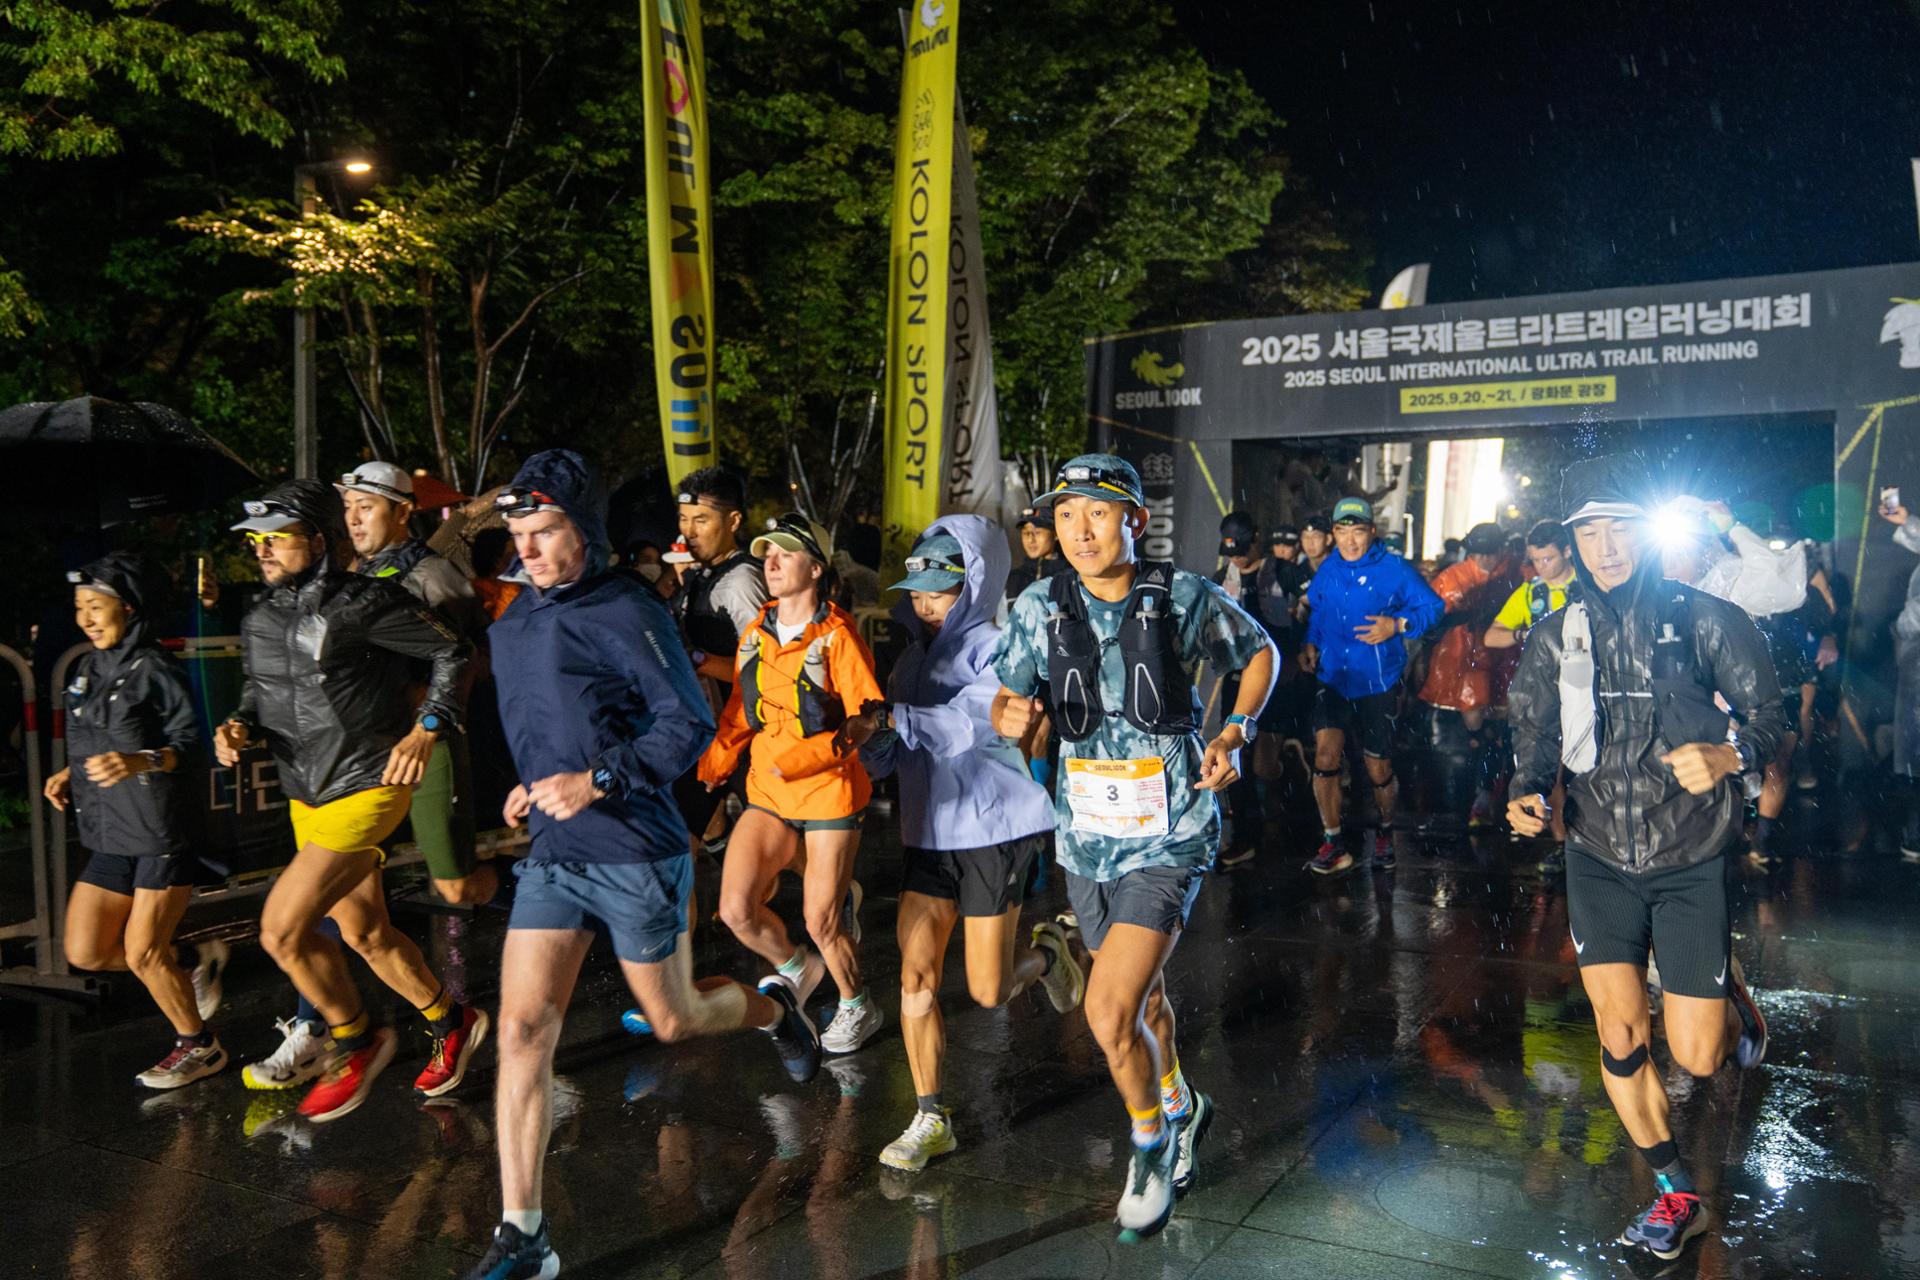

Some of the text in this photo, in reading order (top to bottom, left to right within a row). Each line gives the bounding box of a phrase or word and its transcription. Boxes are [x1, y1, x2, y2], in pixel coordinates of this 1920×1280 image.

[906, 159, 930, 489] KOLON SPORT
[1242, 293, 1811, 366] 2025 서울국제울트라트레일러닝대회
[1284, 340, 1758, 388] 2025 SEOUL INTERNATIONAL ULTRA TRAIL RUNNING
[1106, 784, 1119, 801] 3
